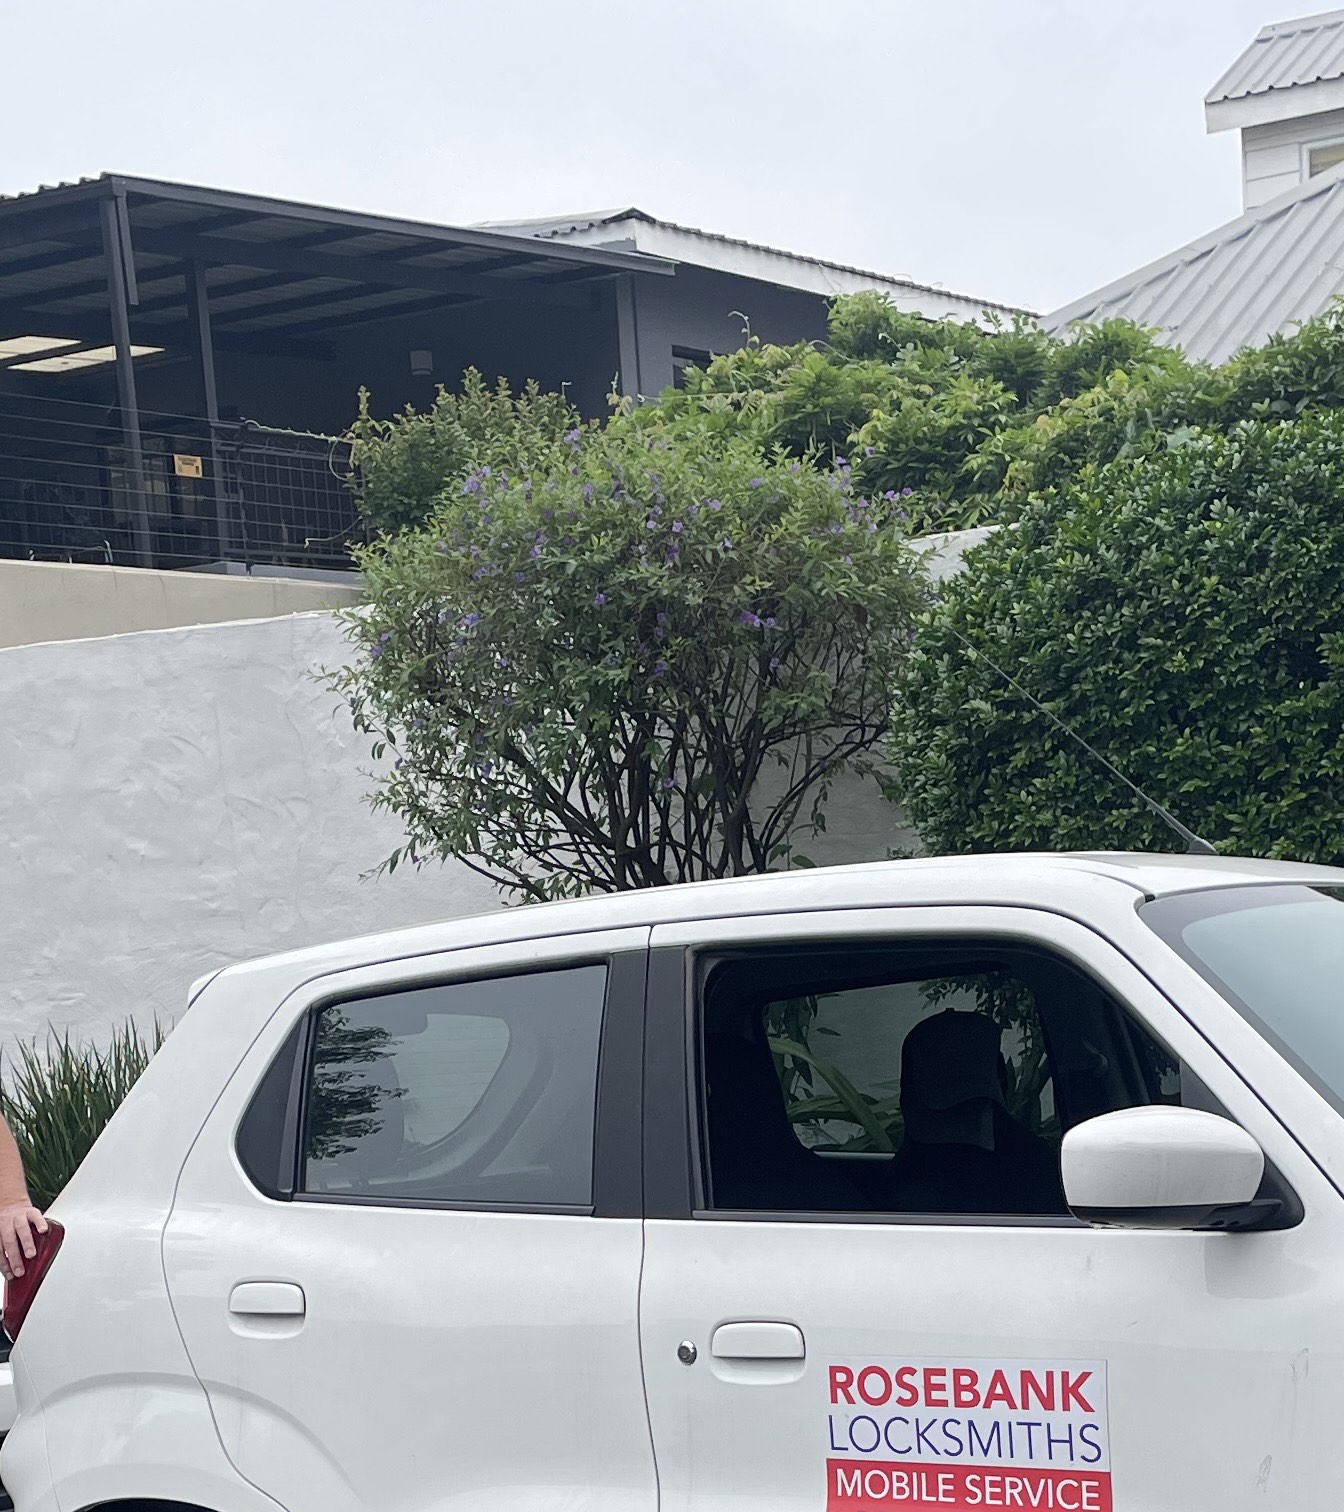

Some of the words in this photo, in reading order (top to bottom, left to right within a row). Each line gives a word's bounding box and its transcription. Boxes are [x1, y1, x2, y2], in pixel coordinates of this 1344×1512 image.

[828, 1365, 1095, 1413] ROSEBANK
[828, 1415, 1102, 1463] LOCKSMITHS
[836, 1468, 956, 1503] MOBILE
[964, 1474, 1101, 1511] SERVICE
